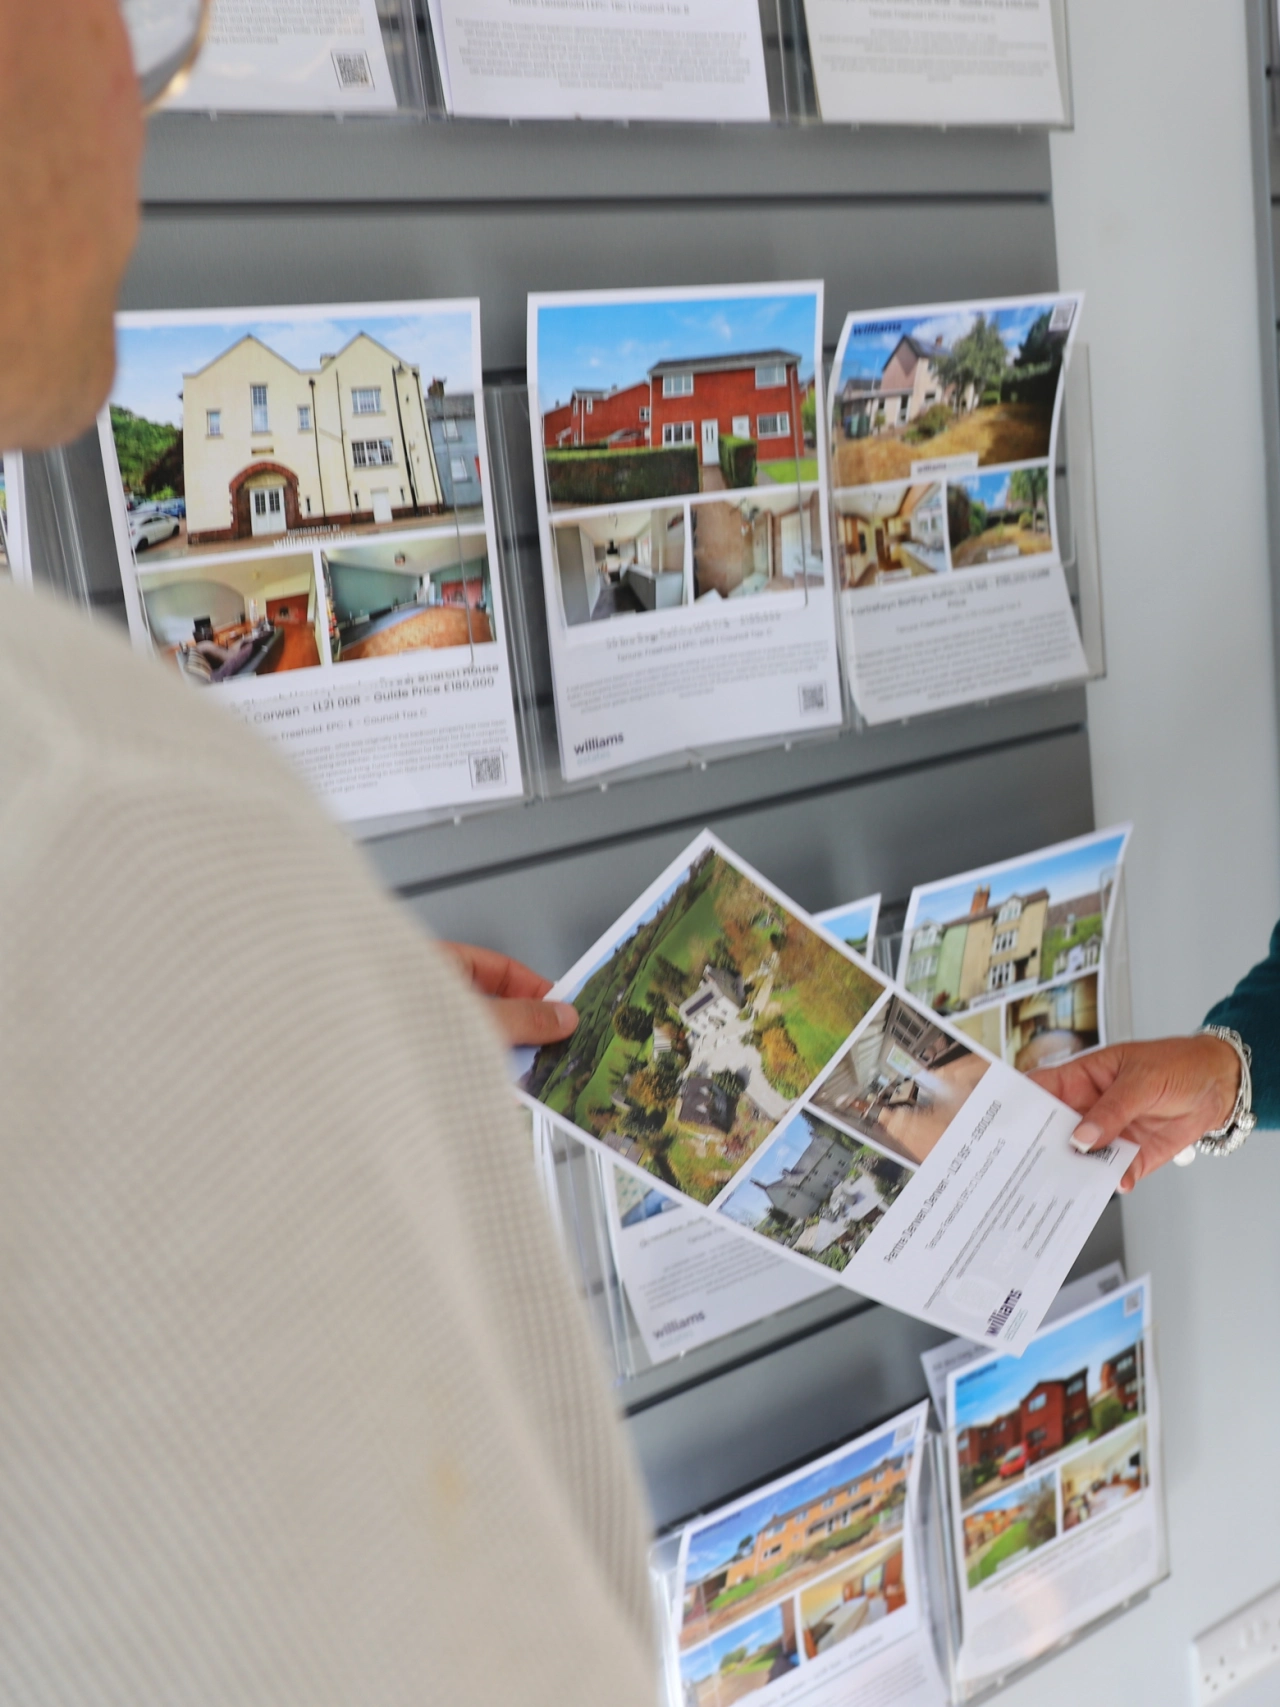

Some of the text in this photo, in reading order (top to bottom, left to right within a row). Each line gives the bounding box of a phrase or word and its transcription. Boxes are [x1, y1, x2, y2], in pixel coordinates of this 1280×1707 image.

[254, 705, 301, 724] Corwen
[313, 696, 334, 714] LL21
[373, 687, 409, 704] Guide
[412, 684, 440, 697] Price
[363, 711, 399, 726] Council
[574, 732, 624, 755] williams
[884, 1236, 908, 1265] Pentre
[652, 1310, 706, 1339] williams
[985, 1288, 1022, 1338] williams
